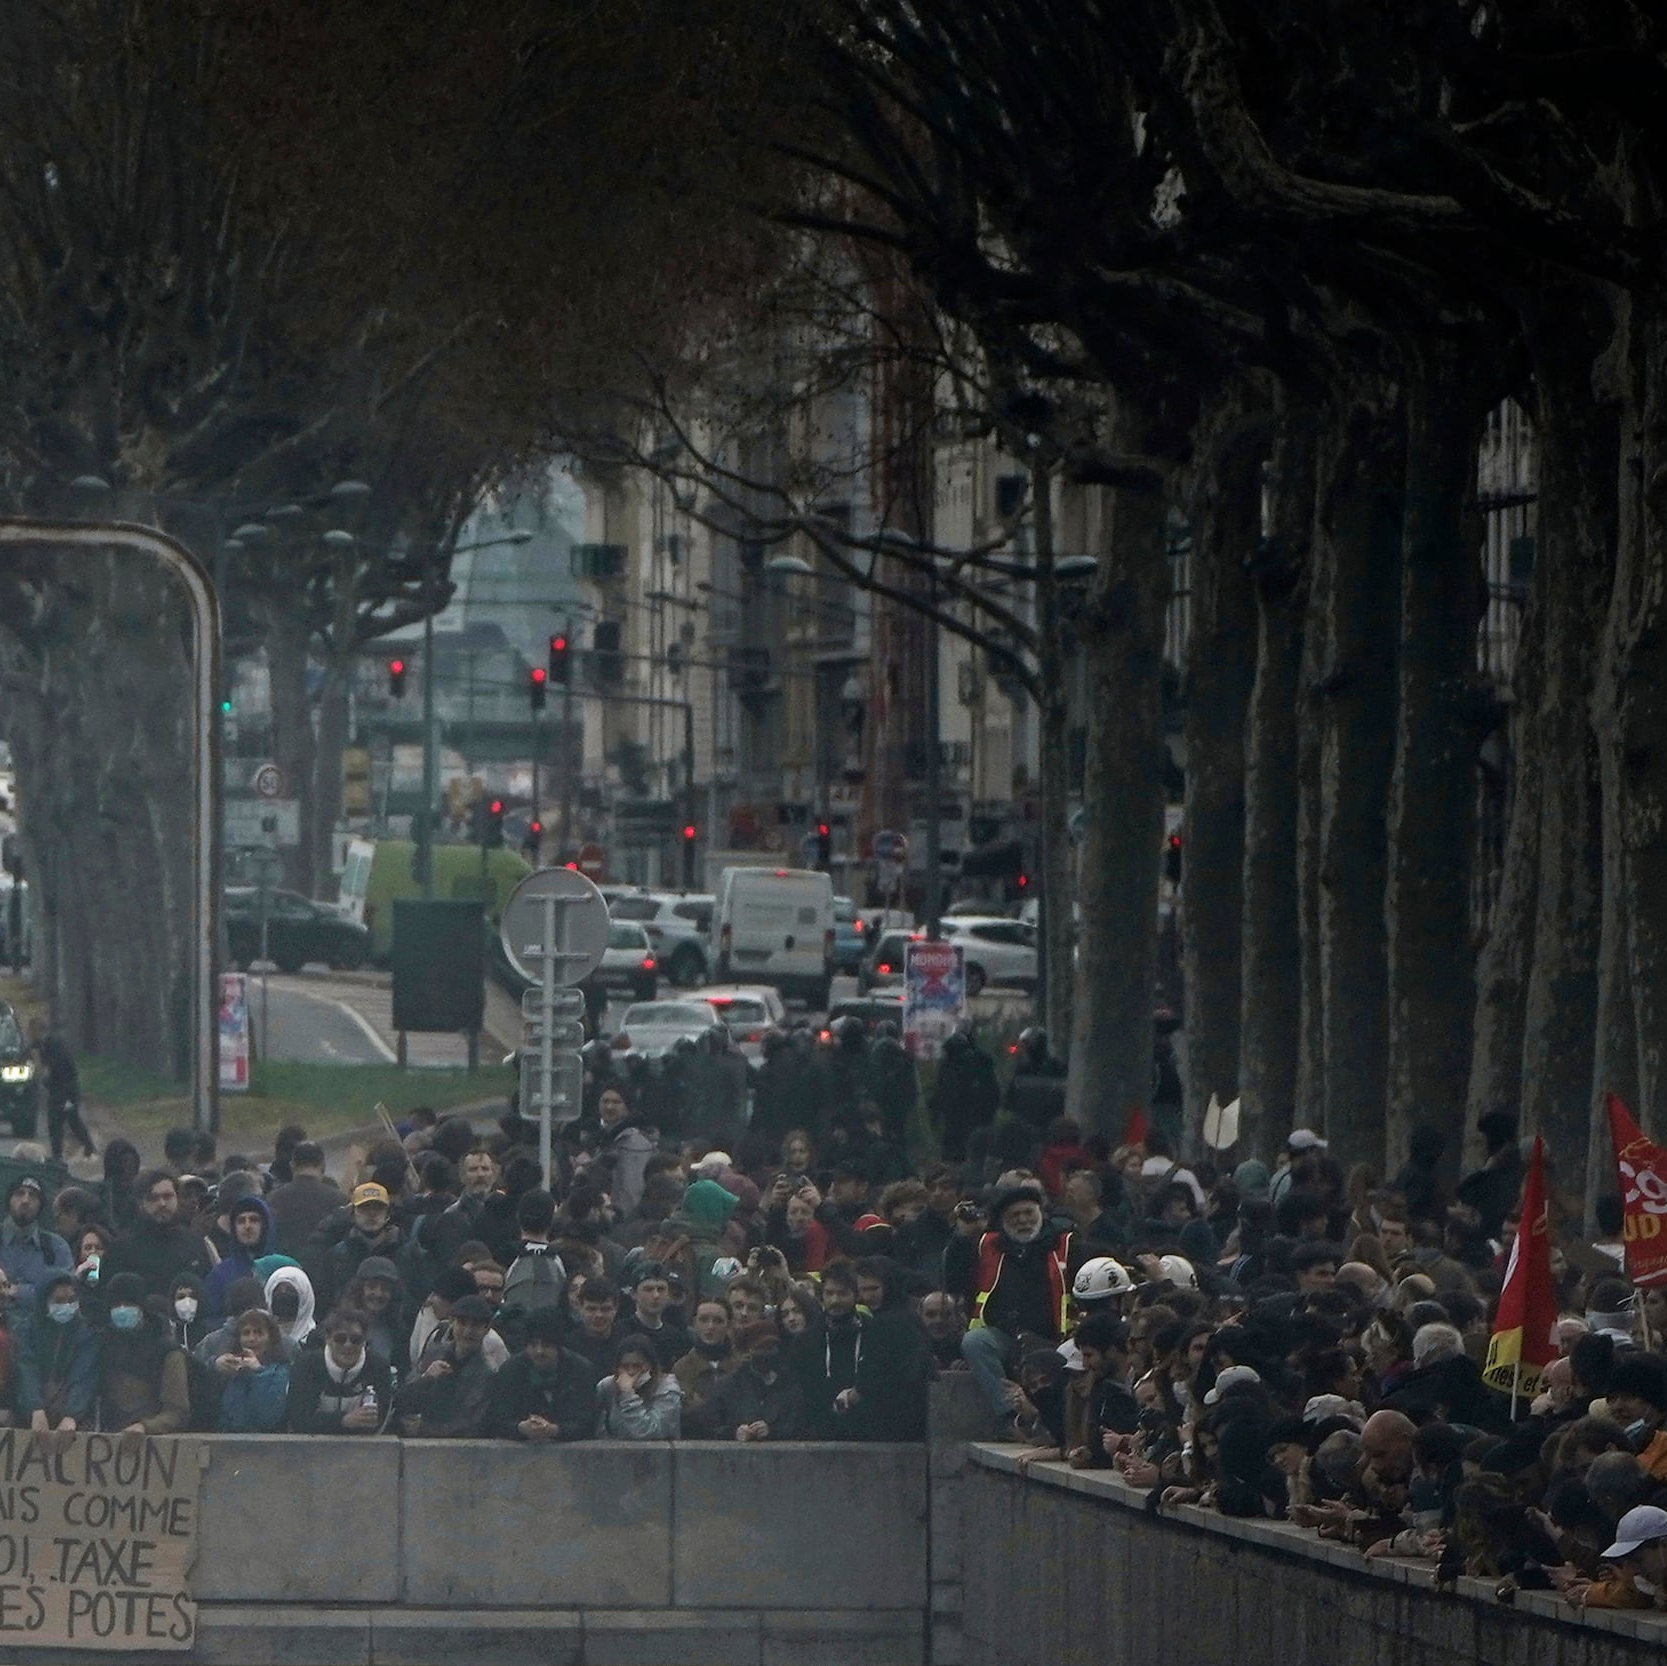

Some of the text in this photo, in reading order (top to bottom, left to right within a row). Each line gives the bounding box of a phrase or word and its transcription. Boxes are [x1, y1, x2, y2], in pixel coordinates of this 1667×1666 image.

[63, 1491, 192, 1537] COMME
[51, 1537, 157, 1588] TAXE
[66, 1589, 194, 1642] POTES
